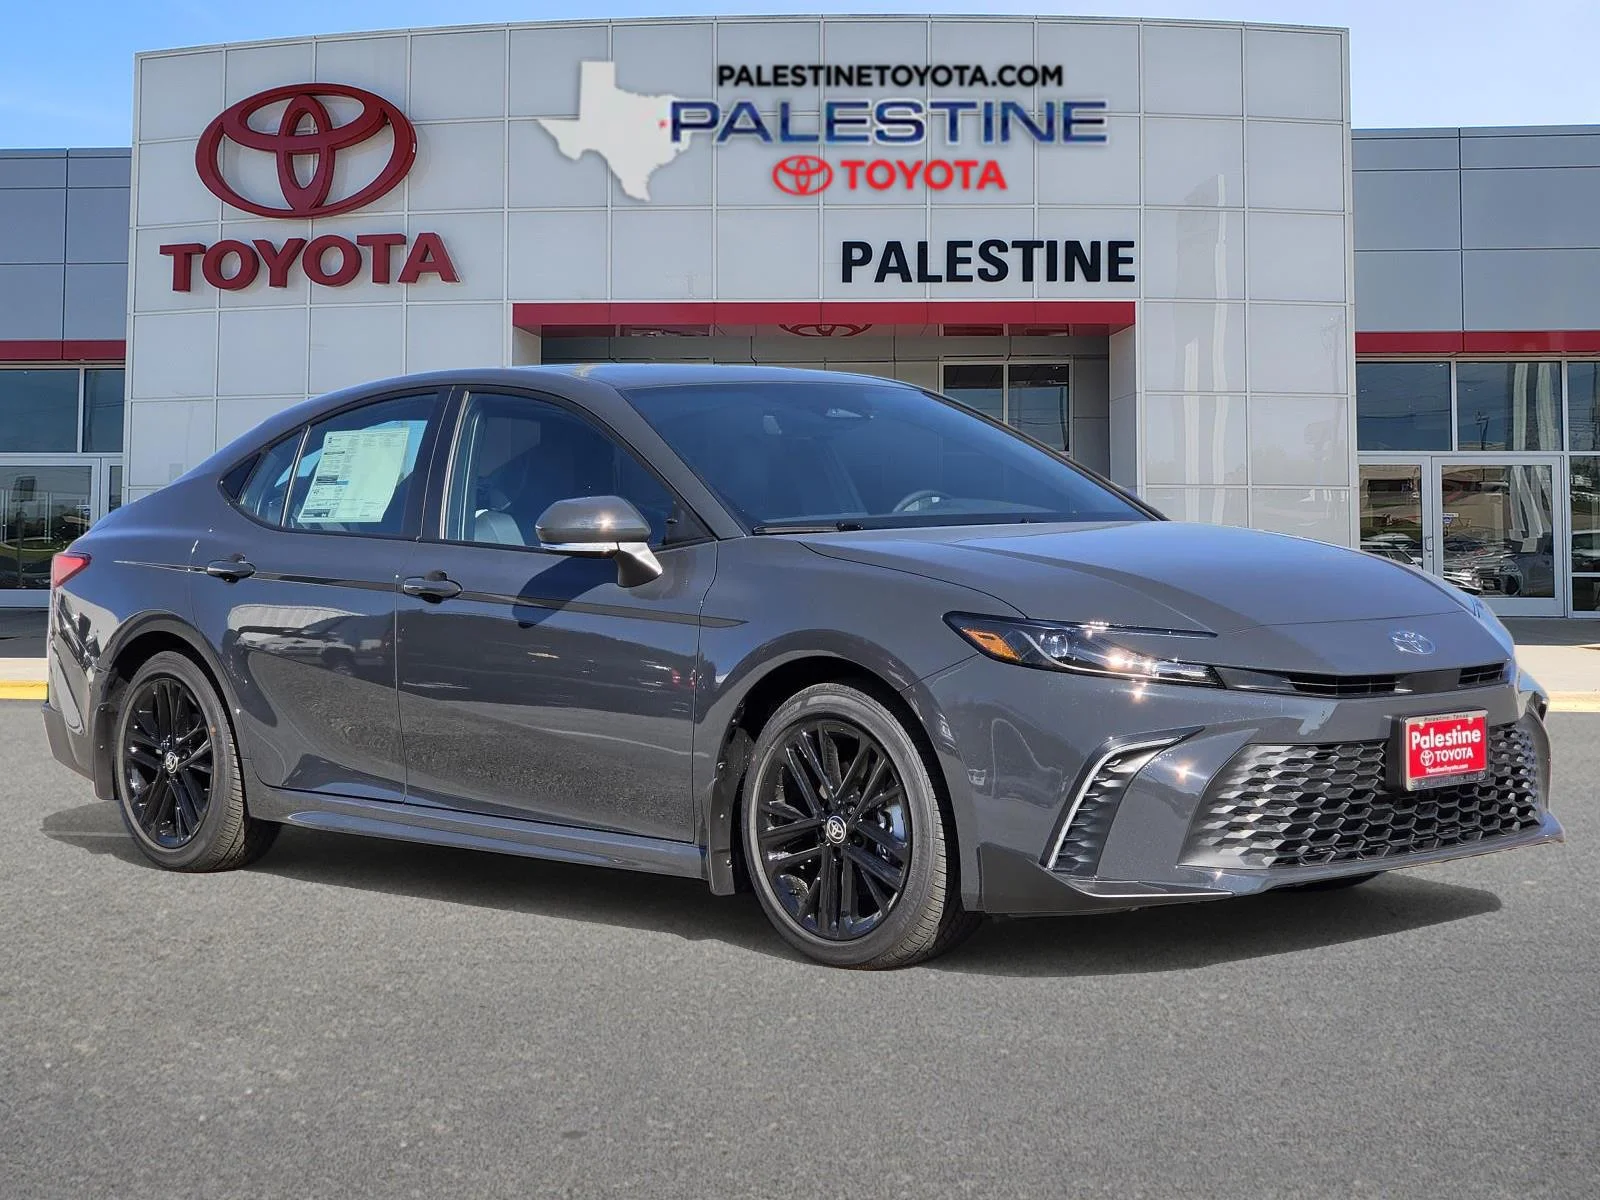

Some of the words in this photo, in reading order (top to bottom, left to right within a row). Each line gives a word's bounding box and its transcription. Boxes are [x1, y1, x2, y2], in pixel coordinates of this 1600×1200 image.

[160, 232, 459, 292] TOYOTA
[842, 239, 1135, 283] PALESTINE
[1411, 725, 1481, 750] Palestine
[1435, 747, 1474, 763] TOYOTA
